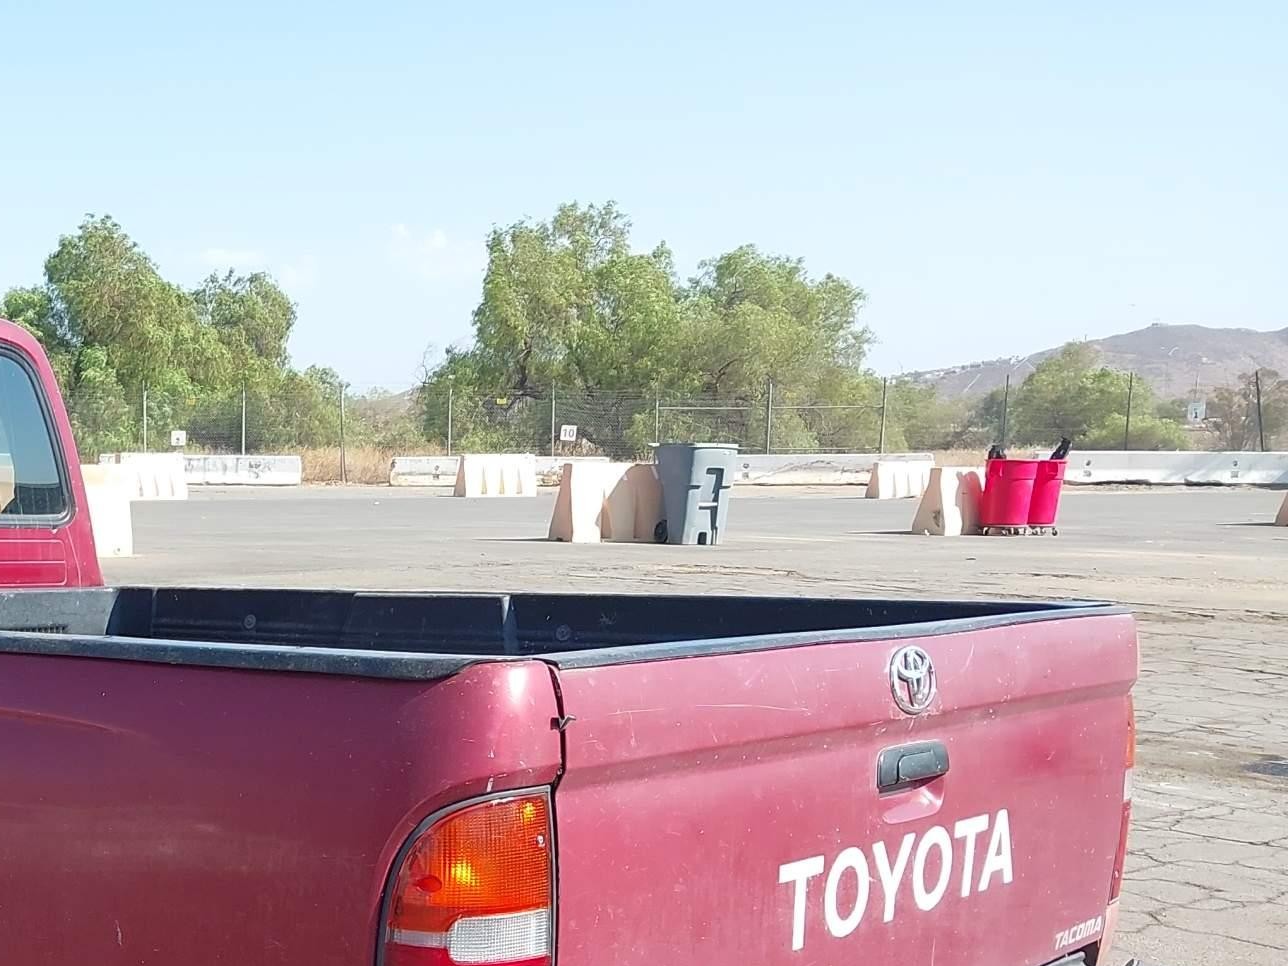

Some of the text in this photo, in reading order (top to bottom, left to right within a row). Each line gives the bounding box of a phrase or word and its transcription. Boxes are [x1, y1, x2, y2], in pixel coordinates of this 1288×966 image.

[562, 428, 575, 438] 10
[778, 808, 1014, 951] TOYOTA
[1055, 915, 1103, 950] TACOMA
